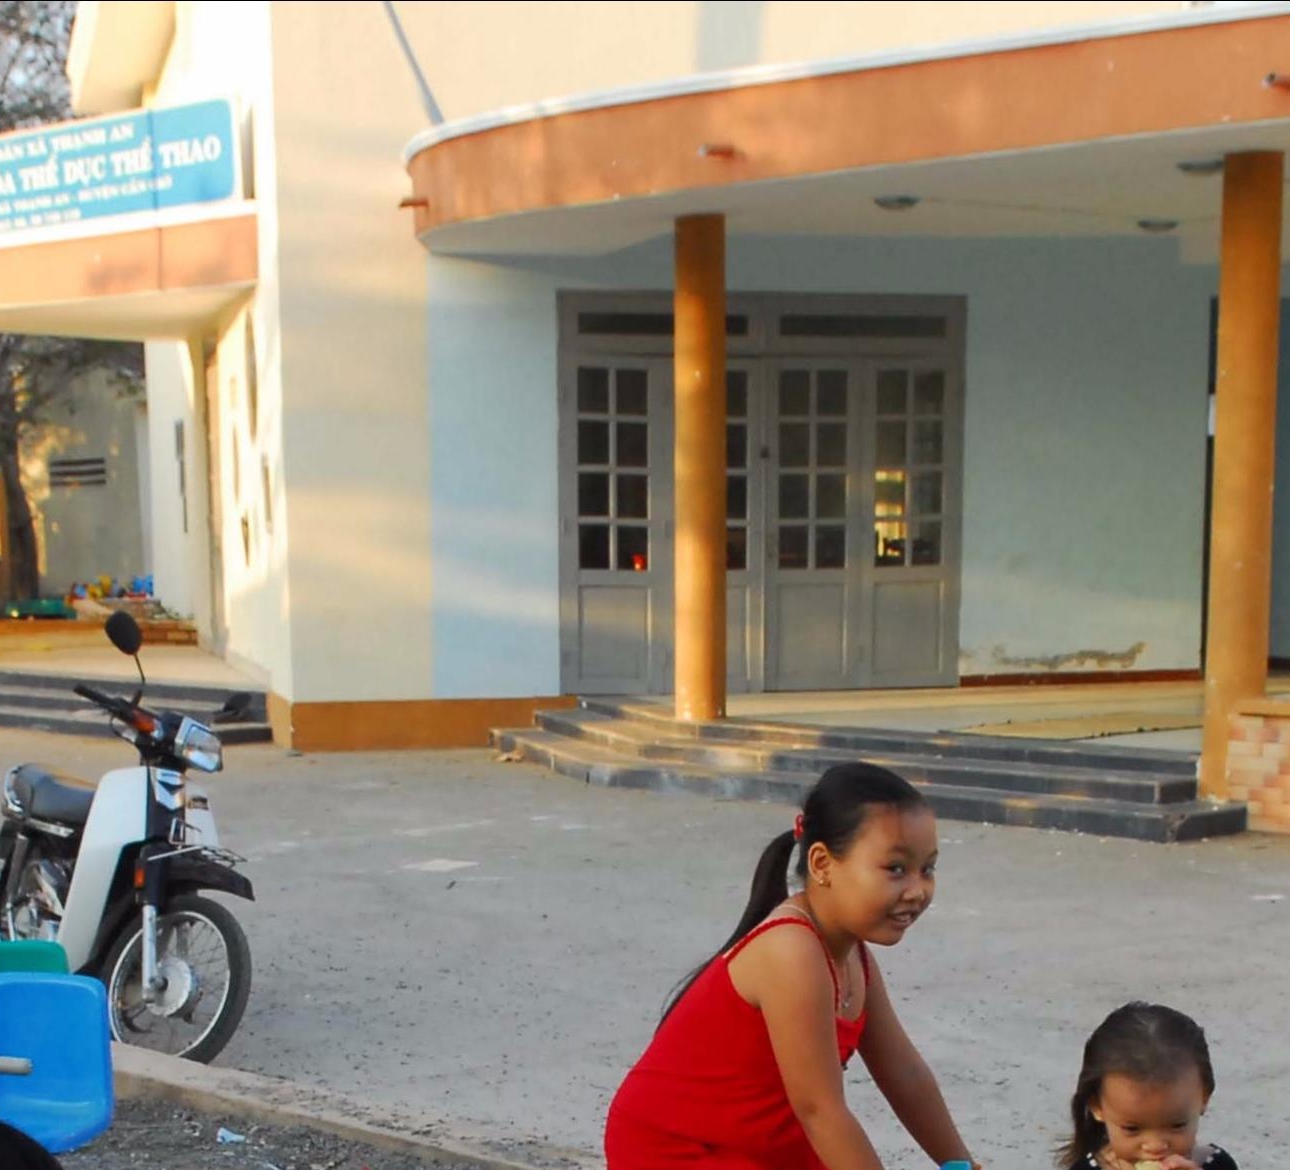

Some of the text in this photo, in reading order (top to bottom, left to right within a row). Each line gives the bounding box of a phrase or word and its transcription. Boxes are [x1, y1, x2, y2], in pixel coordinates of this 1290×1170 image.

[110, 122, 134, 141] AN
[63, 154, 106, 187] DỤC
[160, 134, 222, 169] THAO
